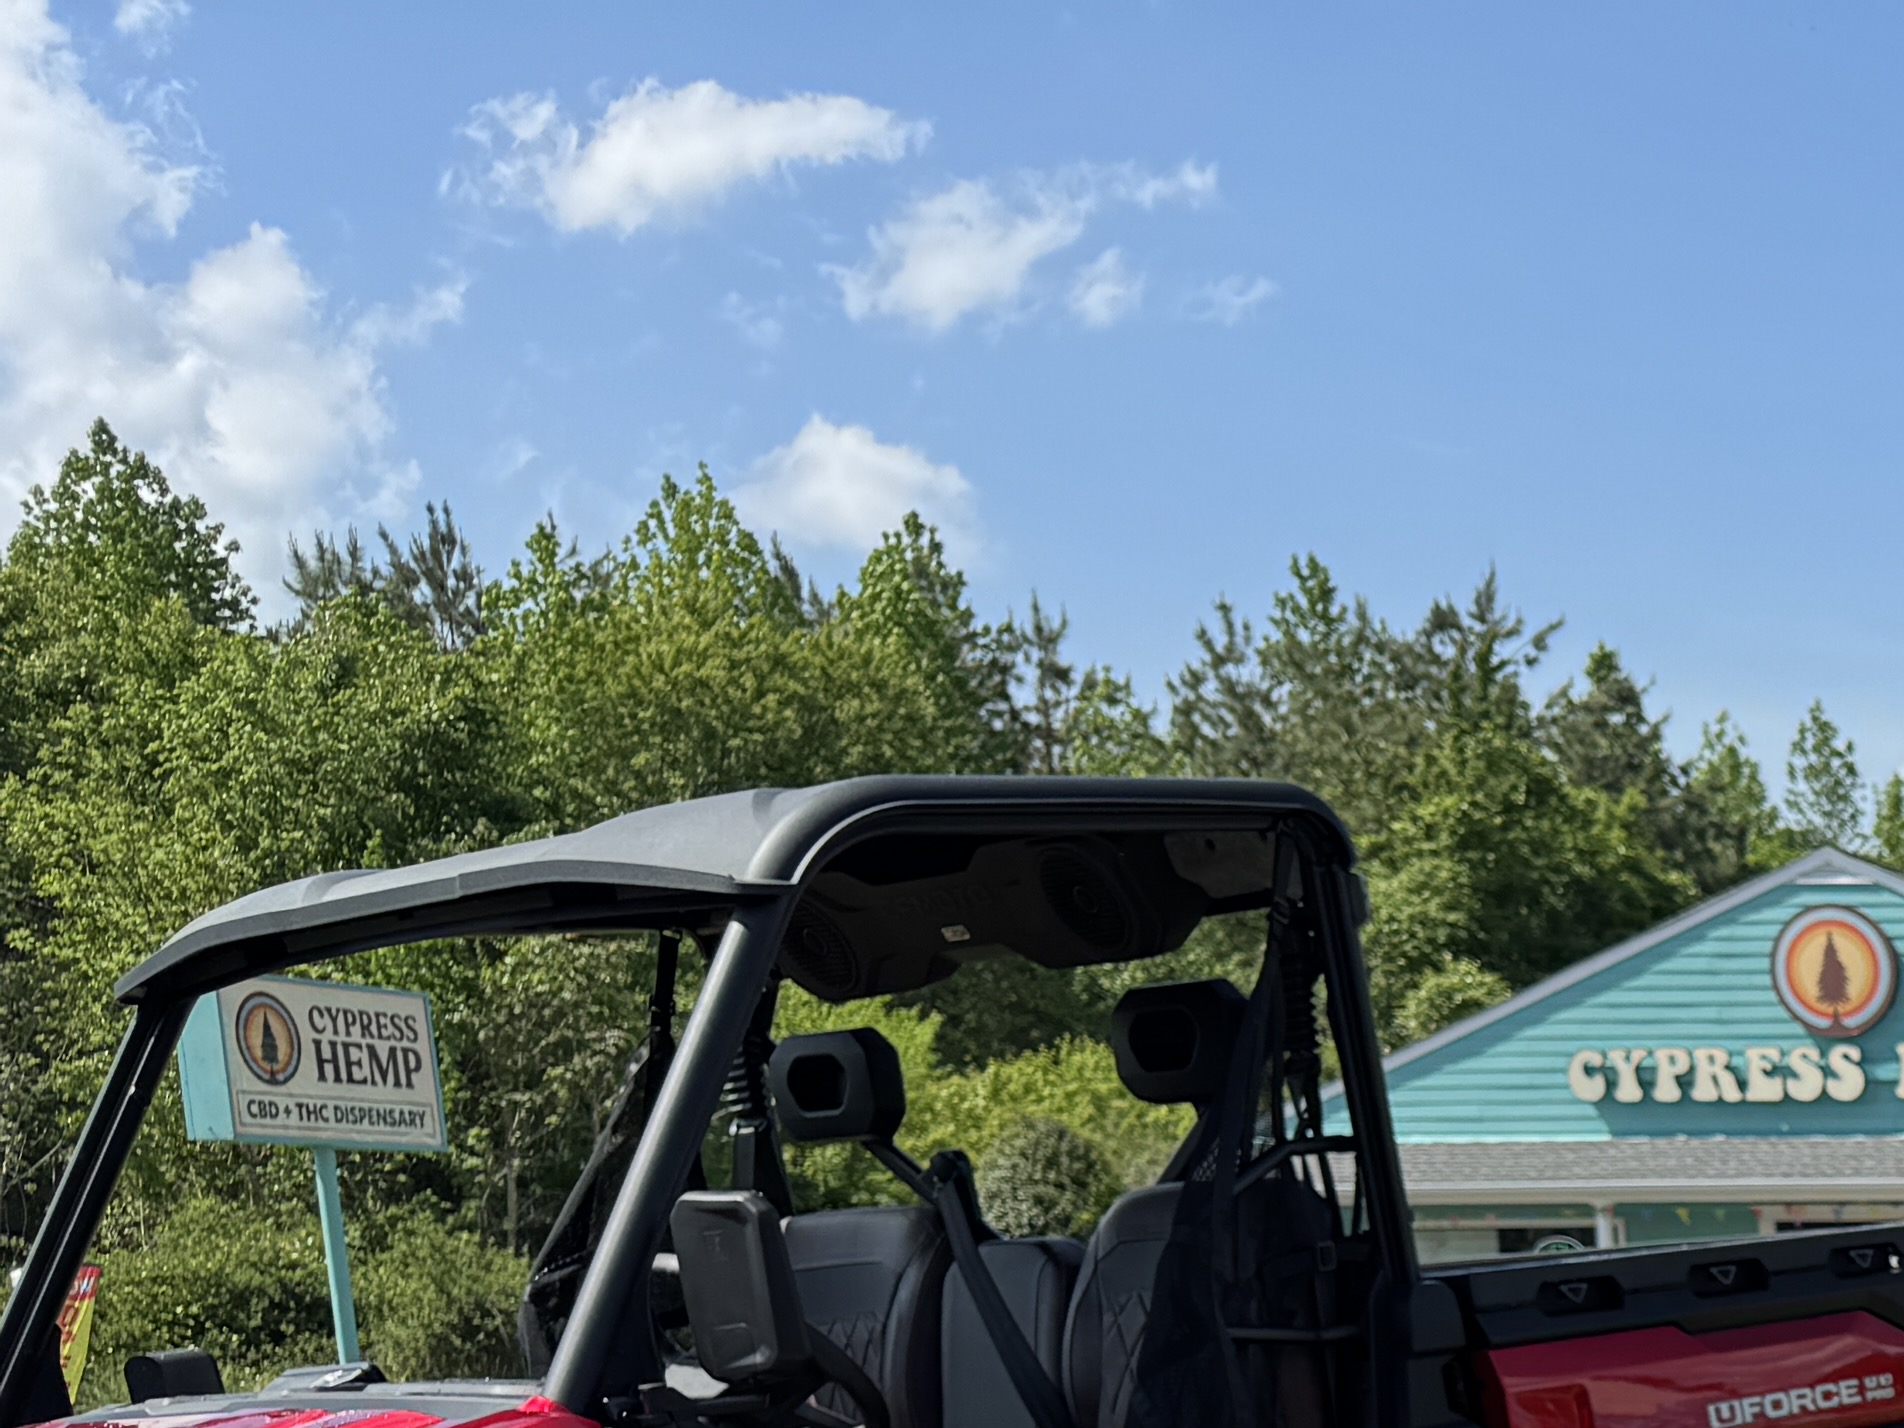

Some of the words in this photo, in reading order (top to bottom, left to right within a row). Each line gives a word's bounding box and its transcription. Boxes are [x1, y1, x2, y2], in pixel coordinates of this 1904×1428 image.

[308, 1005, 418, 1043] CYPRESS
[311, 1038, 422, 1089] HEMP
[1567, 1044, 1866, 1103] CYPRESS
[247, 1099, 279, 1119] CBD
[295, 1103, 329, 1124] THC
[333, 1105, 426, 1129] DISPENSARY
